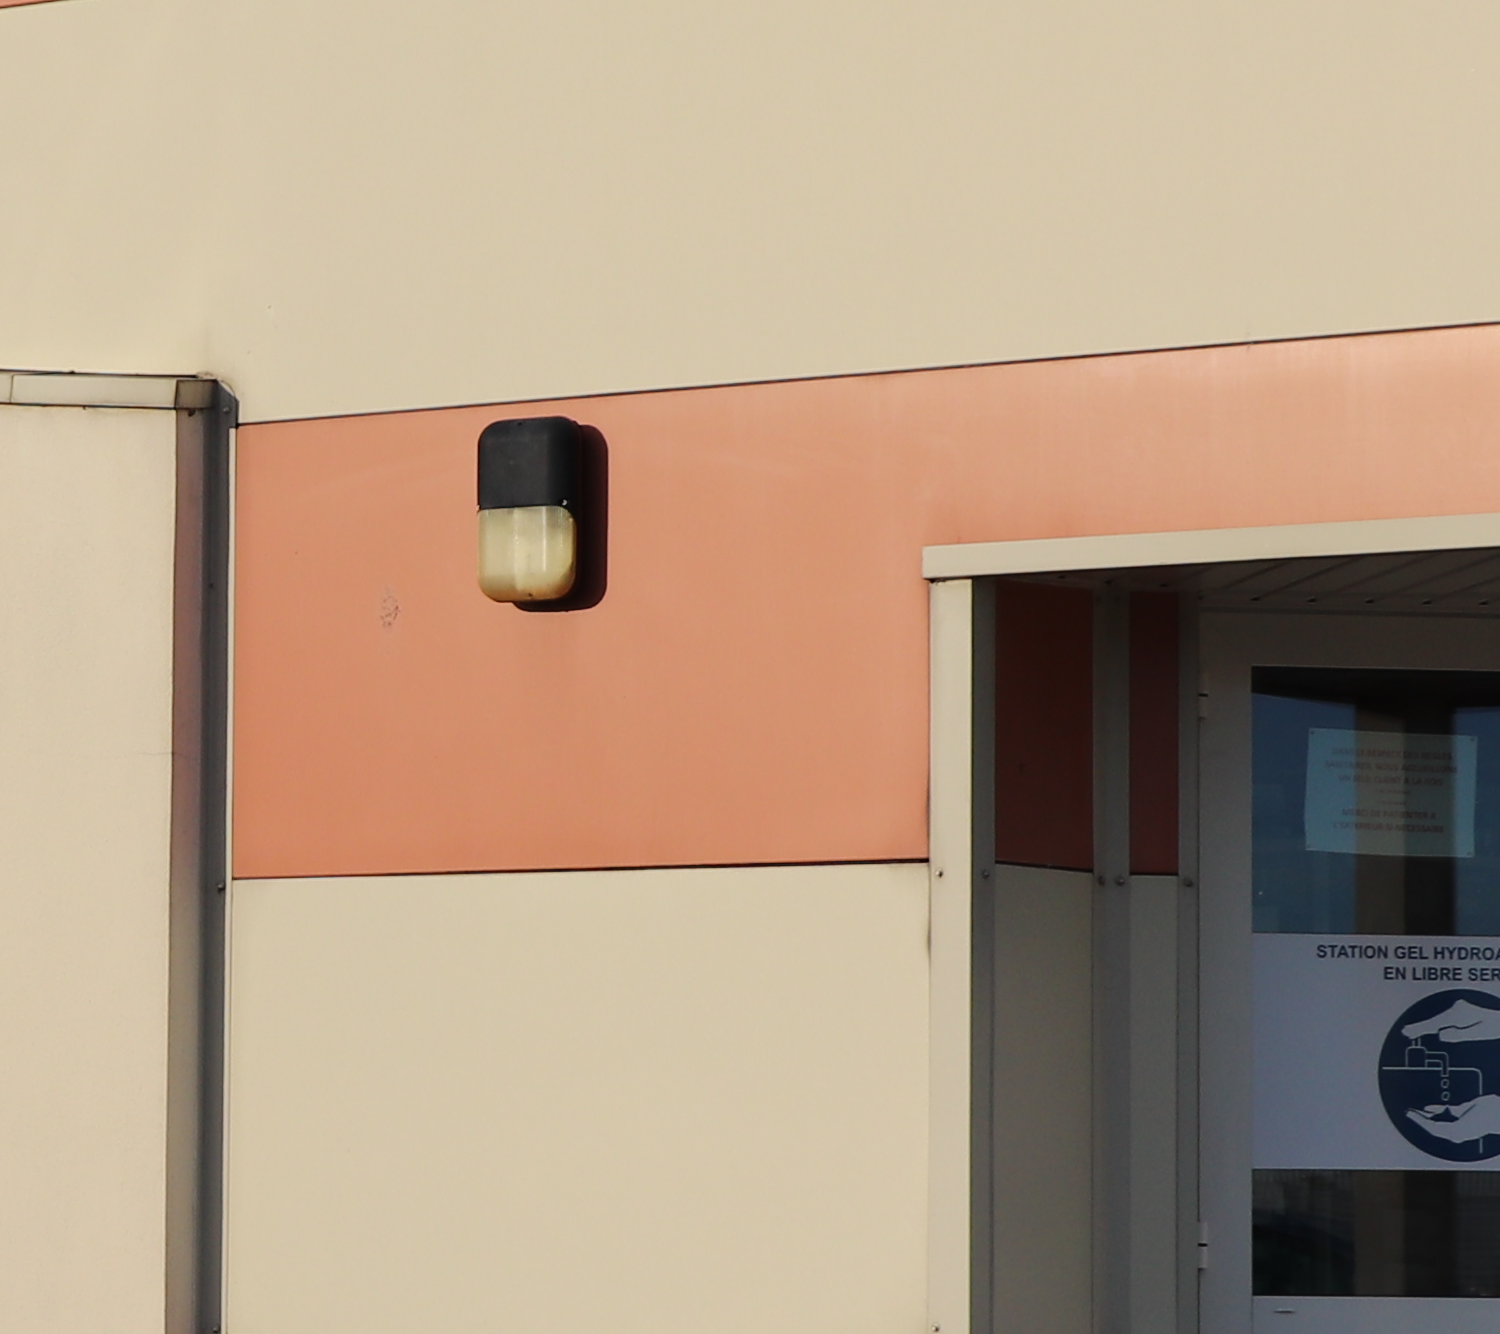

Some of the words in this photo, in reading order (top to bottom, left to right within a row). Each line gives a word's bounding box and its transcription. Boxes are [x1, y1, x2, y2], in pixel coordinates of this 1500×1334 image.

[1316, 944, 1389, 960] STATION
[1394, 946, 1429, 960] GEL
[1383, 966, 1407, 980] EN
[1412, 967, 1462, 981] LIBRE
